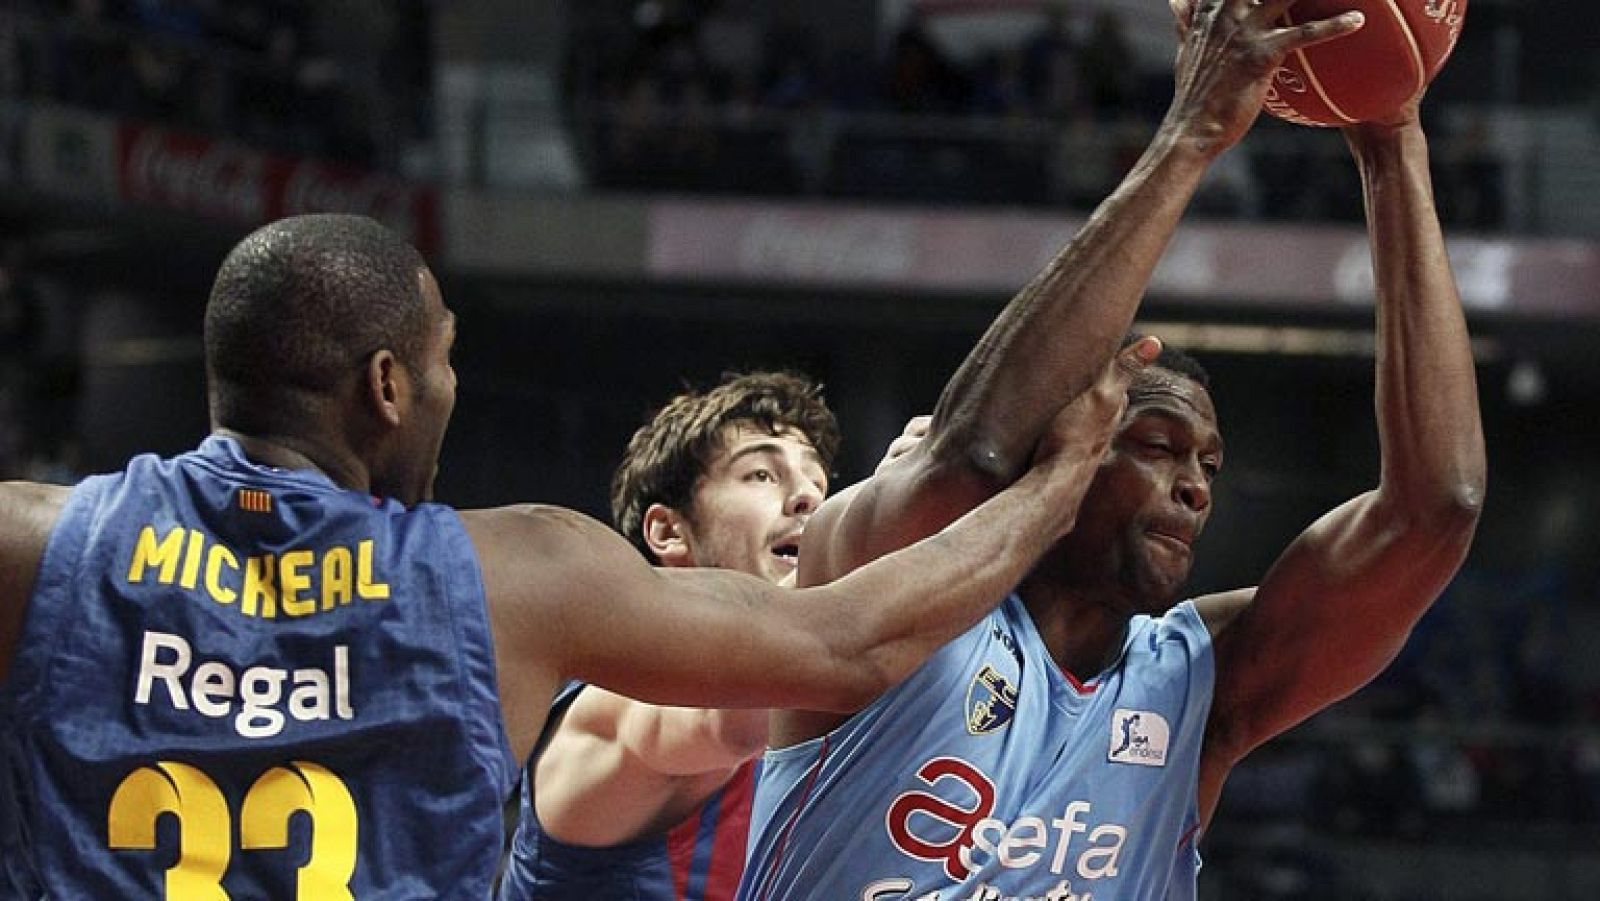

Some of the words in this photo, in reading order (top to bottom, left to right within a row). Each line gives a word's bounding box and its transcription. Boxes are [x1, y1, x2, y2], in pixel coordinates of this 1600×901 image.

[128, 526, 390, 618] MICKEAL
[135, 631, 353, 738] Regal
[108, 761, 358, 901] 33
[885, 756, 1128, 882] asefa
